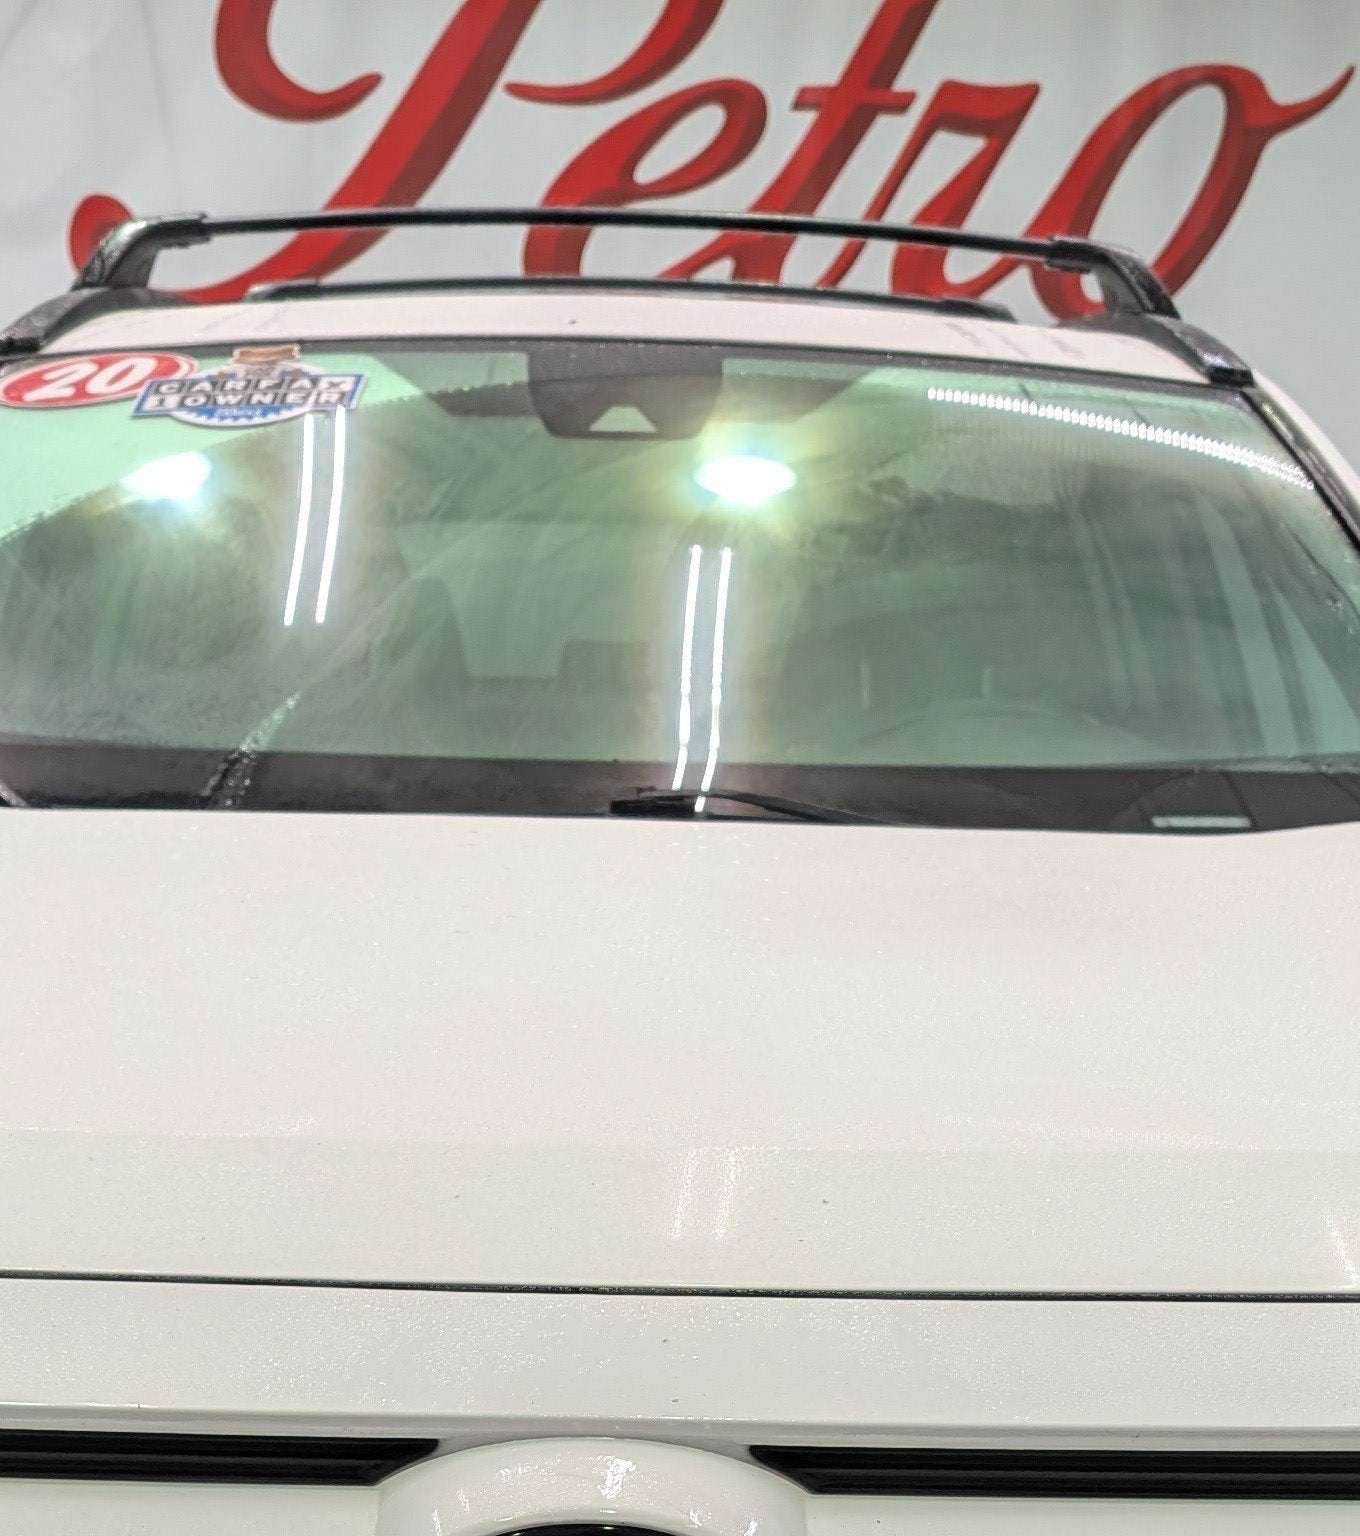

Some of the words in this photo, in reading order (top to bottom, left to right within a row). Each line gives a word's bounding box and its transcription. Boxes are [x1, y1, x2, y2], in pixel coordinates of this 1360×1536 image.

[22, 357, 159, 402] 20
[158, 375, 353, 395] CARFAX
[183, 390, 340, 408] OWNER
